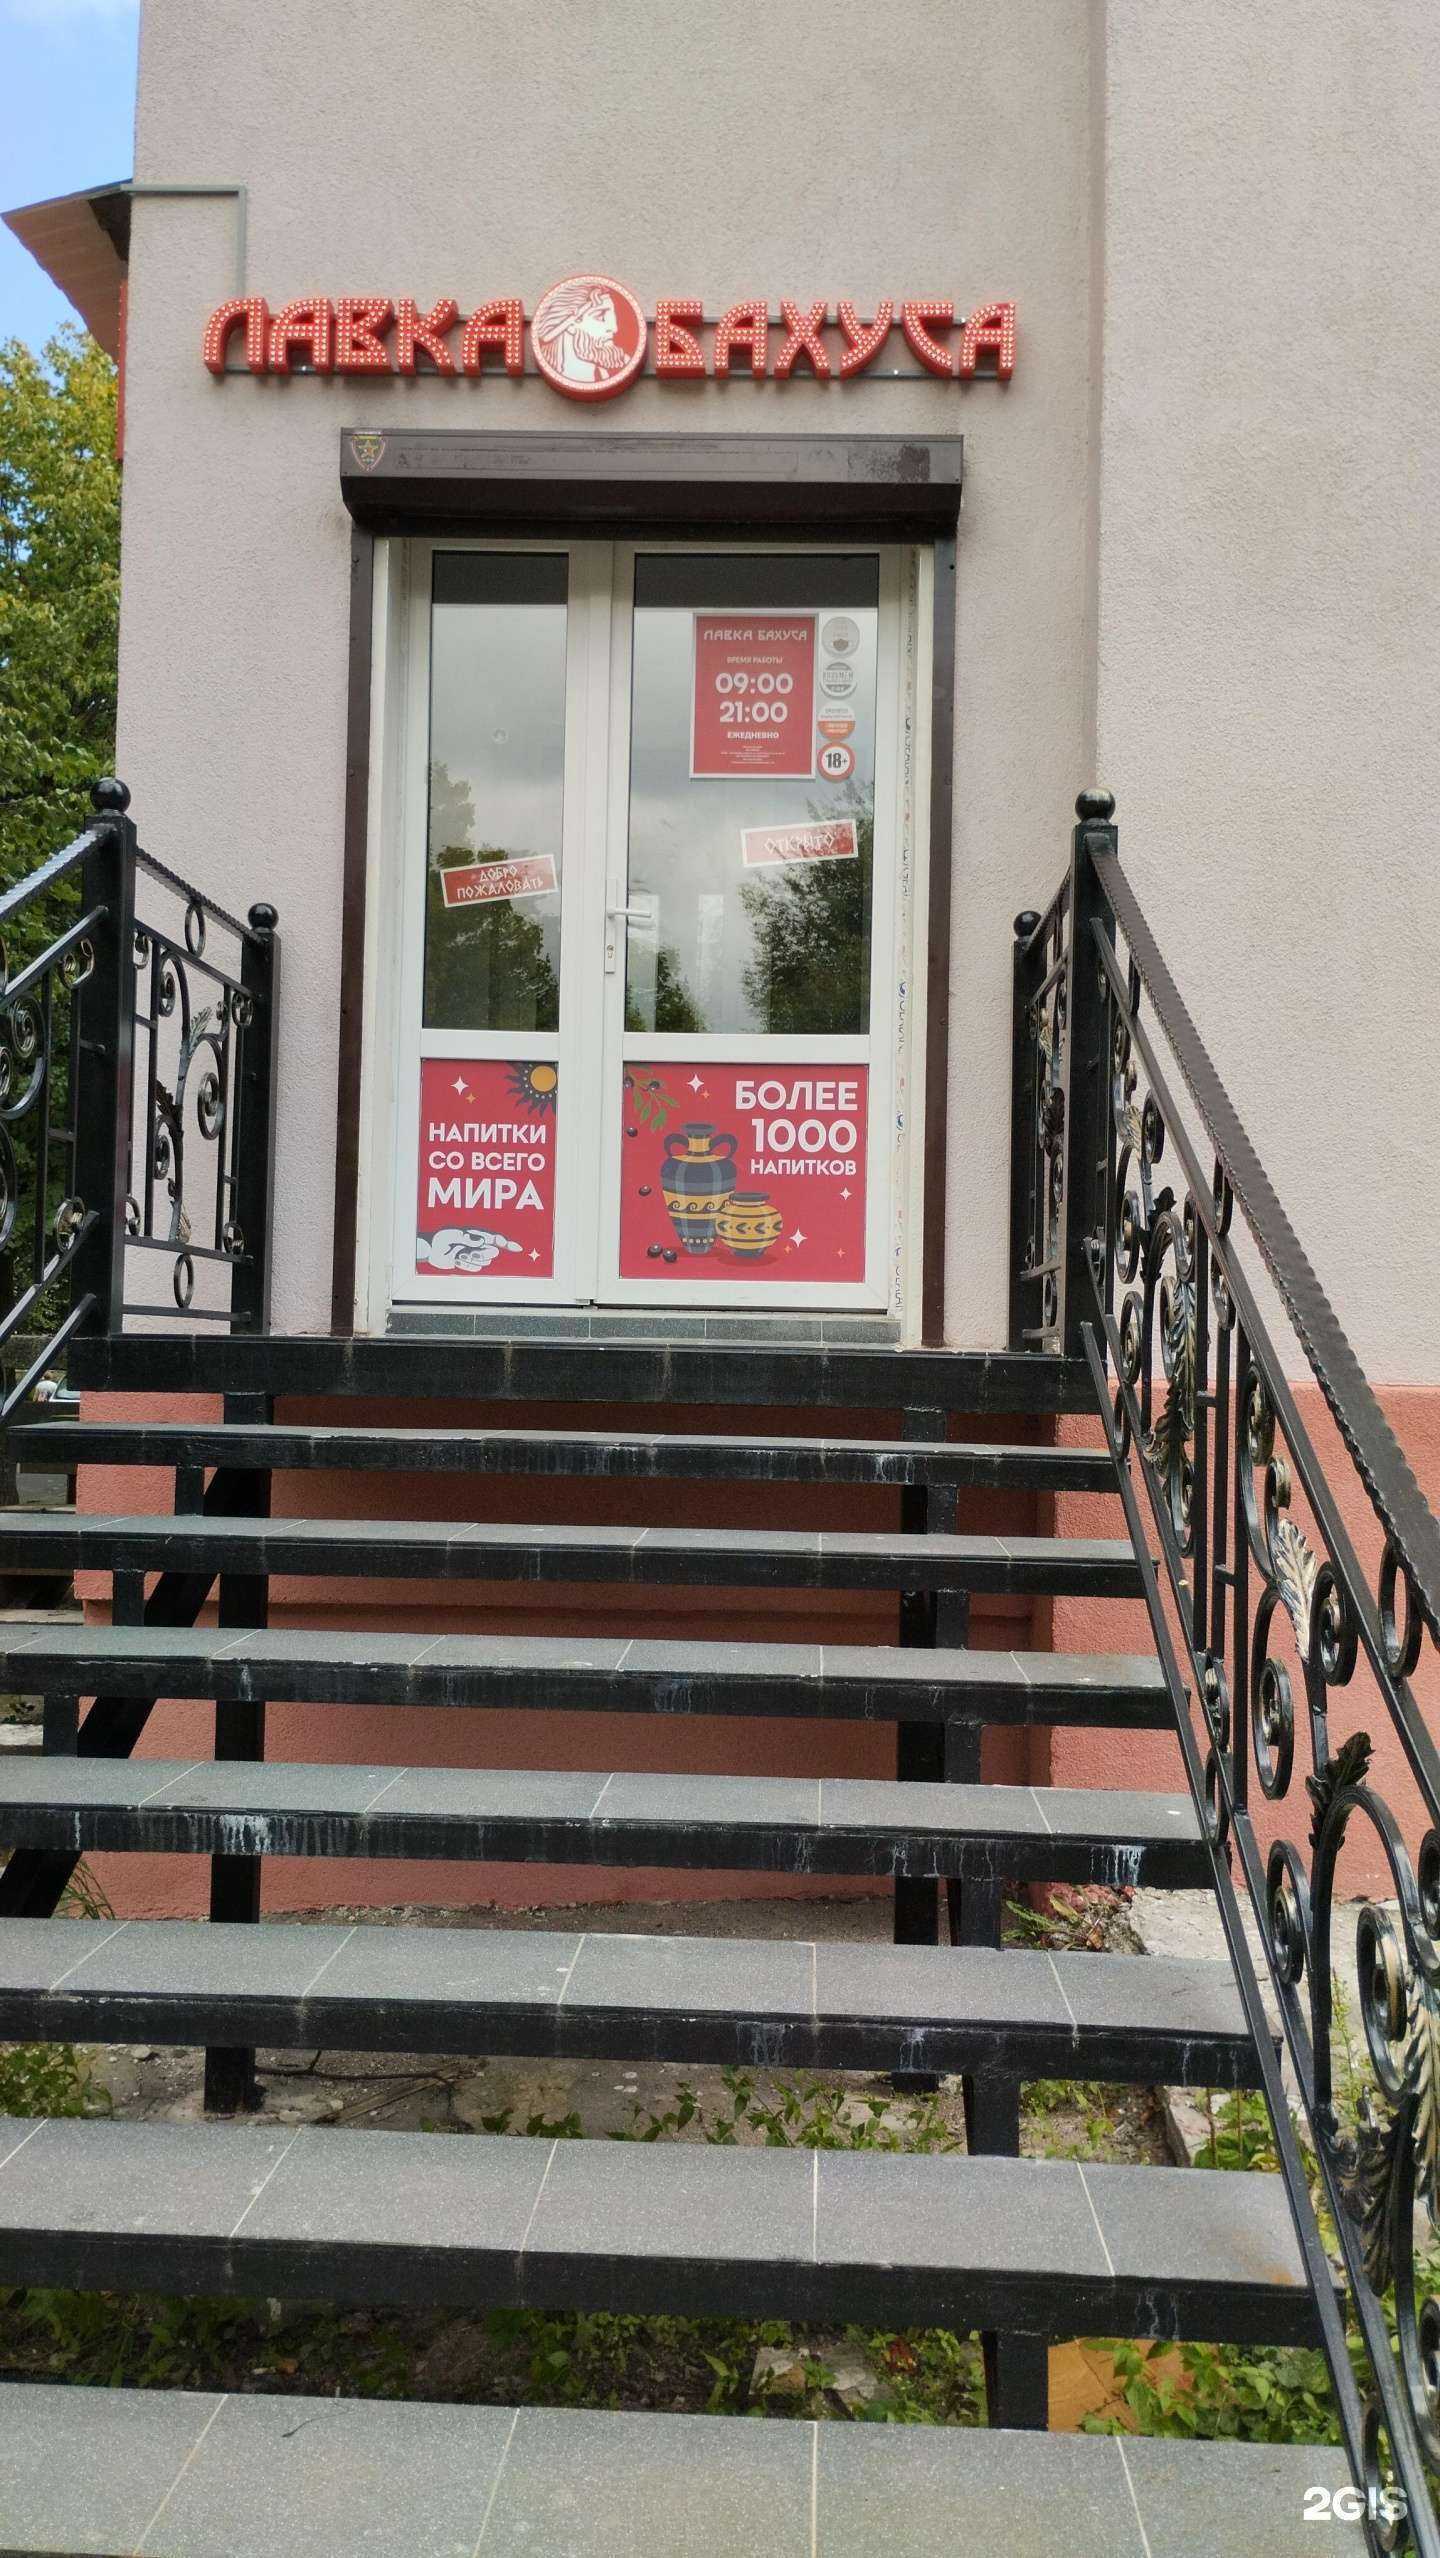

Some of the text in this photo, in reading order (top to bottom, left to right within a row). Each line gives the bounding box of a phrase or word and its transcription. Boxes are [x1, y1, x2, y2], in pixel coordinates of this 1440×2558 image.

[203, 297, 1016, 381] ЛАВКА БАХУСА
[704, 629, 807, 641] ЛАВКА БАХУСА
[715, 672, 794, 694] 09:00
[719, 701, 788, 723] 21:00
[727, 731, 779, 740] ЕЖЕДНЕВНО
[825, 753, 848, 768] 18+
[479, 864, 519, 883] ДОБРО
[456, 876, 544, 900] ПОЖАЛОВАТЬ
[735, 1080, 858, 1112] БОЛЕЕ
[428, 1122, 546, 1145] НАПИТКИ
[751, 1118, 858, 1154] 1000
[428, 1152, 546, 1172] СО ВСЕГО
[750, 1158, 857, 1177] НАПИТКОВ
[427, 1177, 544, 1211] МИРА
